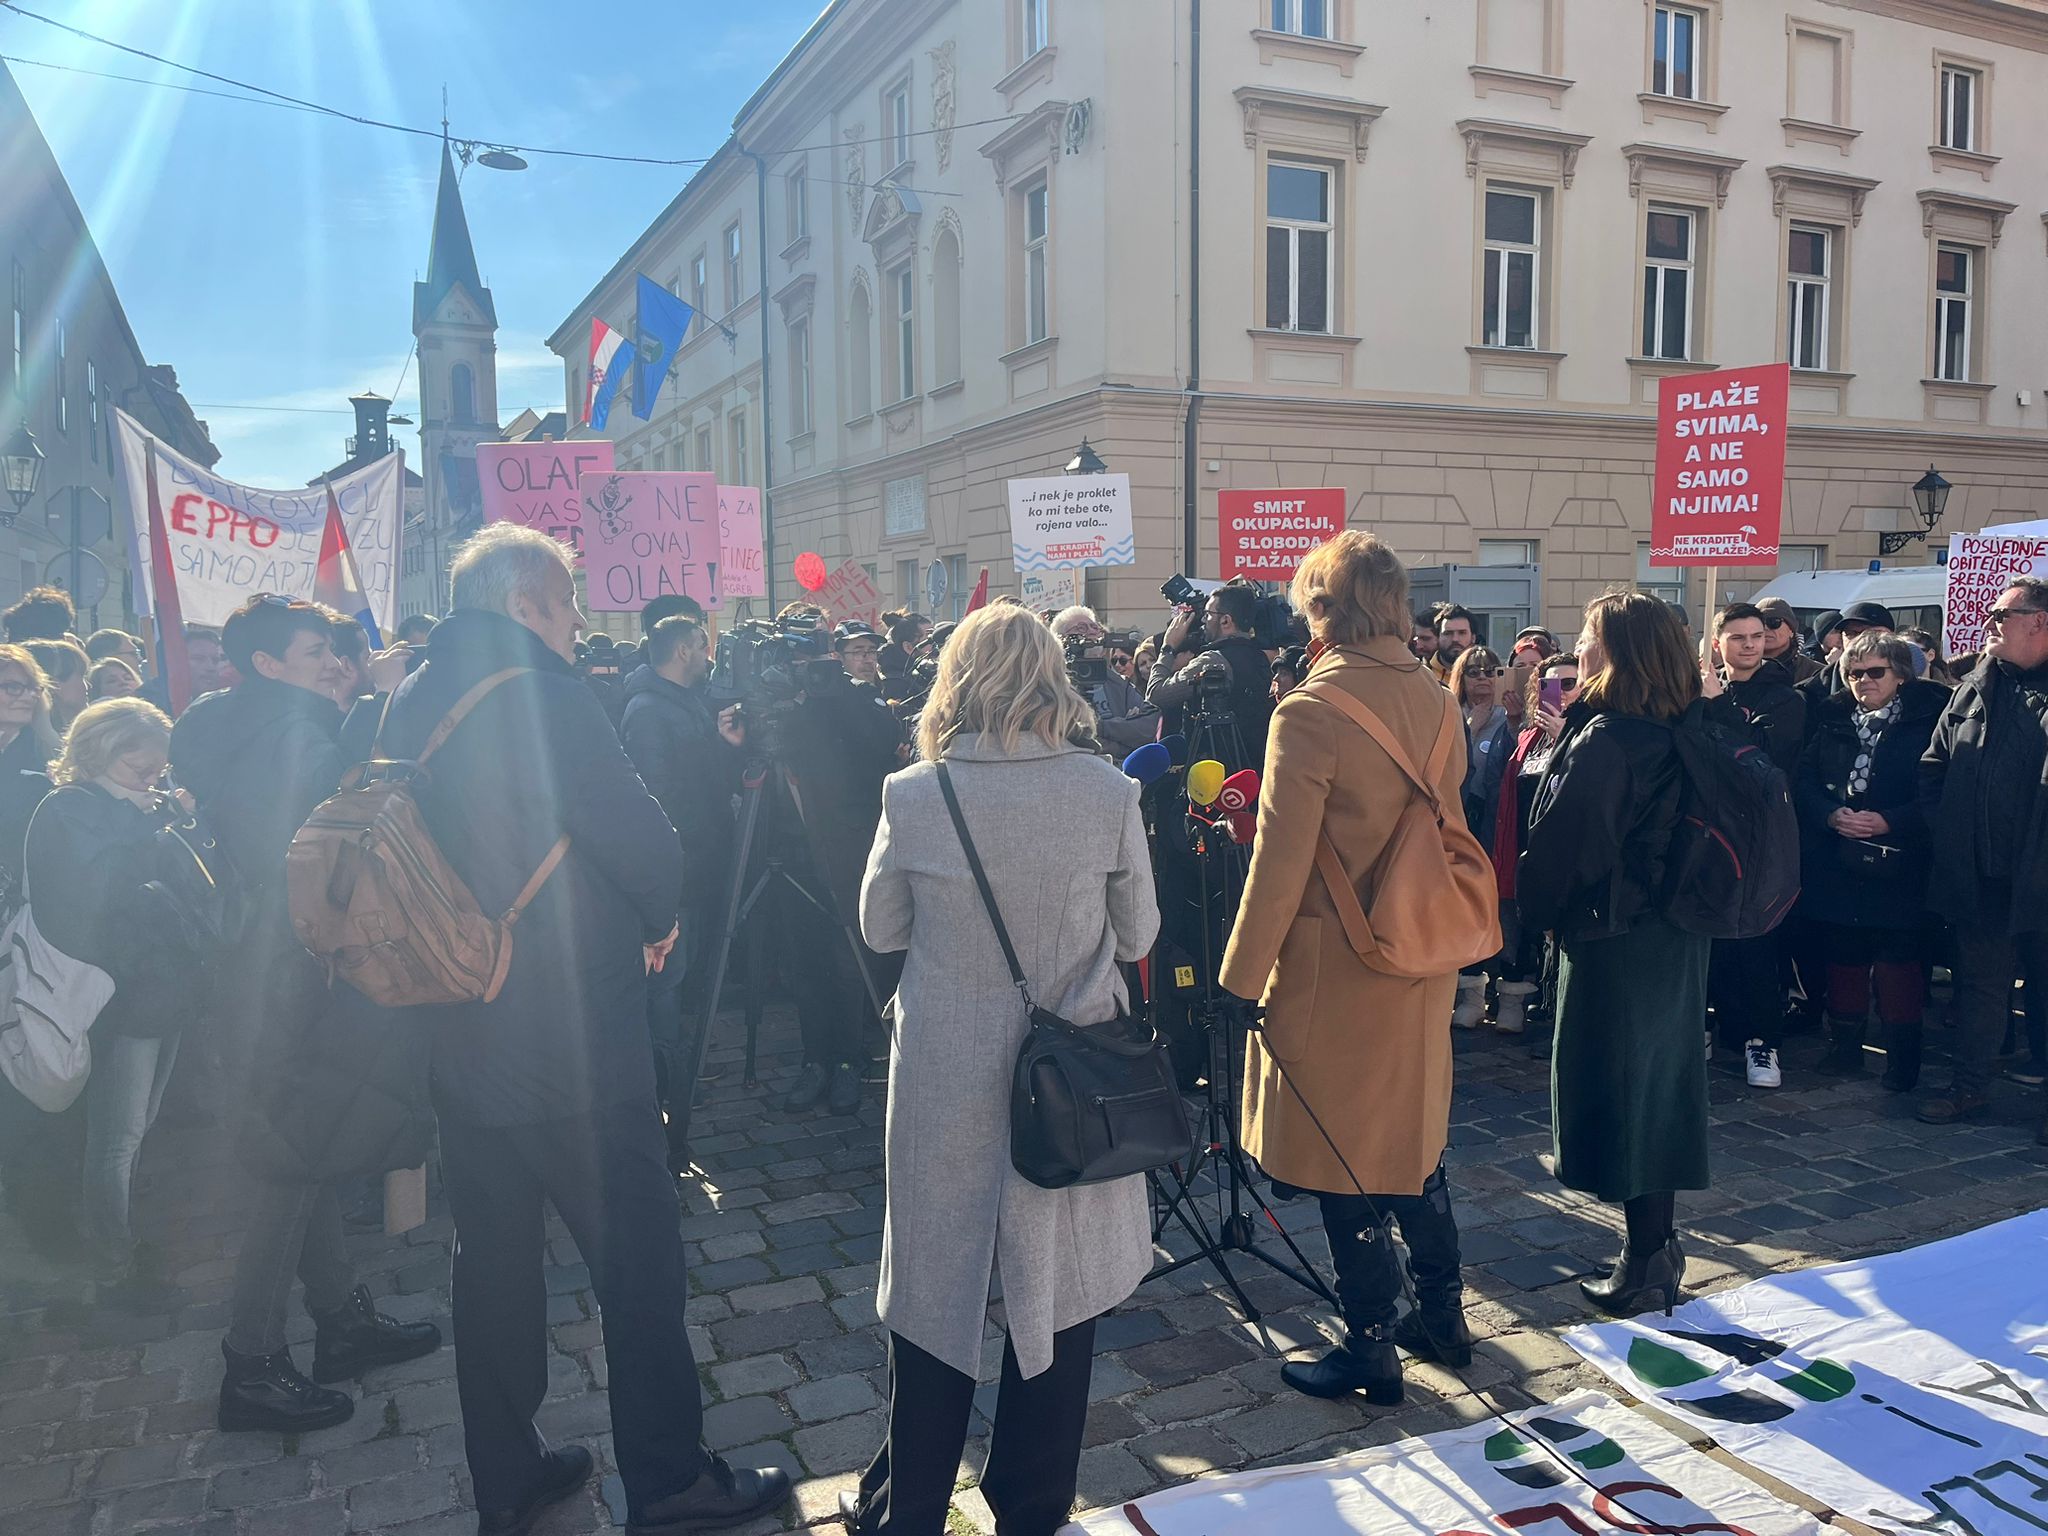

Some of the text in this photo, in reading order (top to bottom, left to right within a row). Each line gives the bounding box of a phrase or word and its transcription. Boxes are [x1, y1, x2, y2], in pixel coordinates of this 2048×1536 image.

[1677, 381, 1760, 412] PLAŽE
[1675, 413, 1768, 438] SVIMA,
[1684, 441, 1744, 463] A NE
[497, 455, 598, 492] OLAF
[1677, 468, 1748, 489] SAMO
[656, 485, 705, 522] NE
[1039, 490, 1060, 502] nek
[1062, 489, 1074, 502] je
[1076, 487, 1117, 501] proklet
[1669, 493, 1759, 515] NJIMA!
[516, 498, 582, 522] VAS
[736, 500, 755, 515] ZA
[1028, 503, 1113, 517] ko mi tebe ote,
[1253, 500, 1306, 514] SMRT
[171, 494, 280, 548] EPPO
[1035, 517, 1108, 533] rojena valo...
[1232, 516, 1335, 532] OKUPACIJI,
[632, 531, 691, 560] OVAJ
[1675, 535, 1740, 545] NE KRADITE
[719, 546, 761, 572] TINEC
[1674, 547, 1699, 555] NAM
[177, 545, 257, 586] SAMO
[722, 583, 753, 595] AGREB
[1948, 572, 2006, 587] SREBRO
